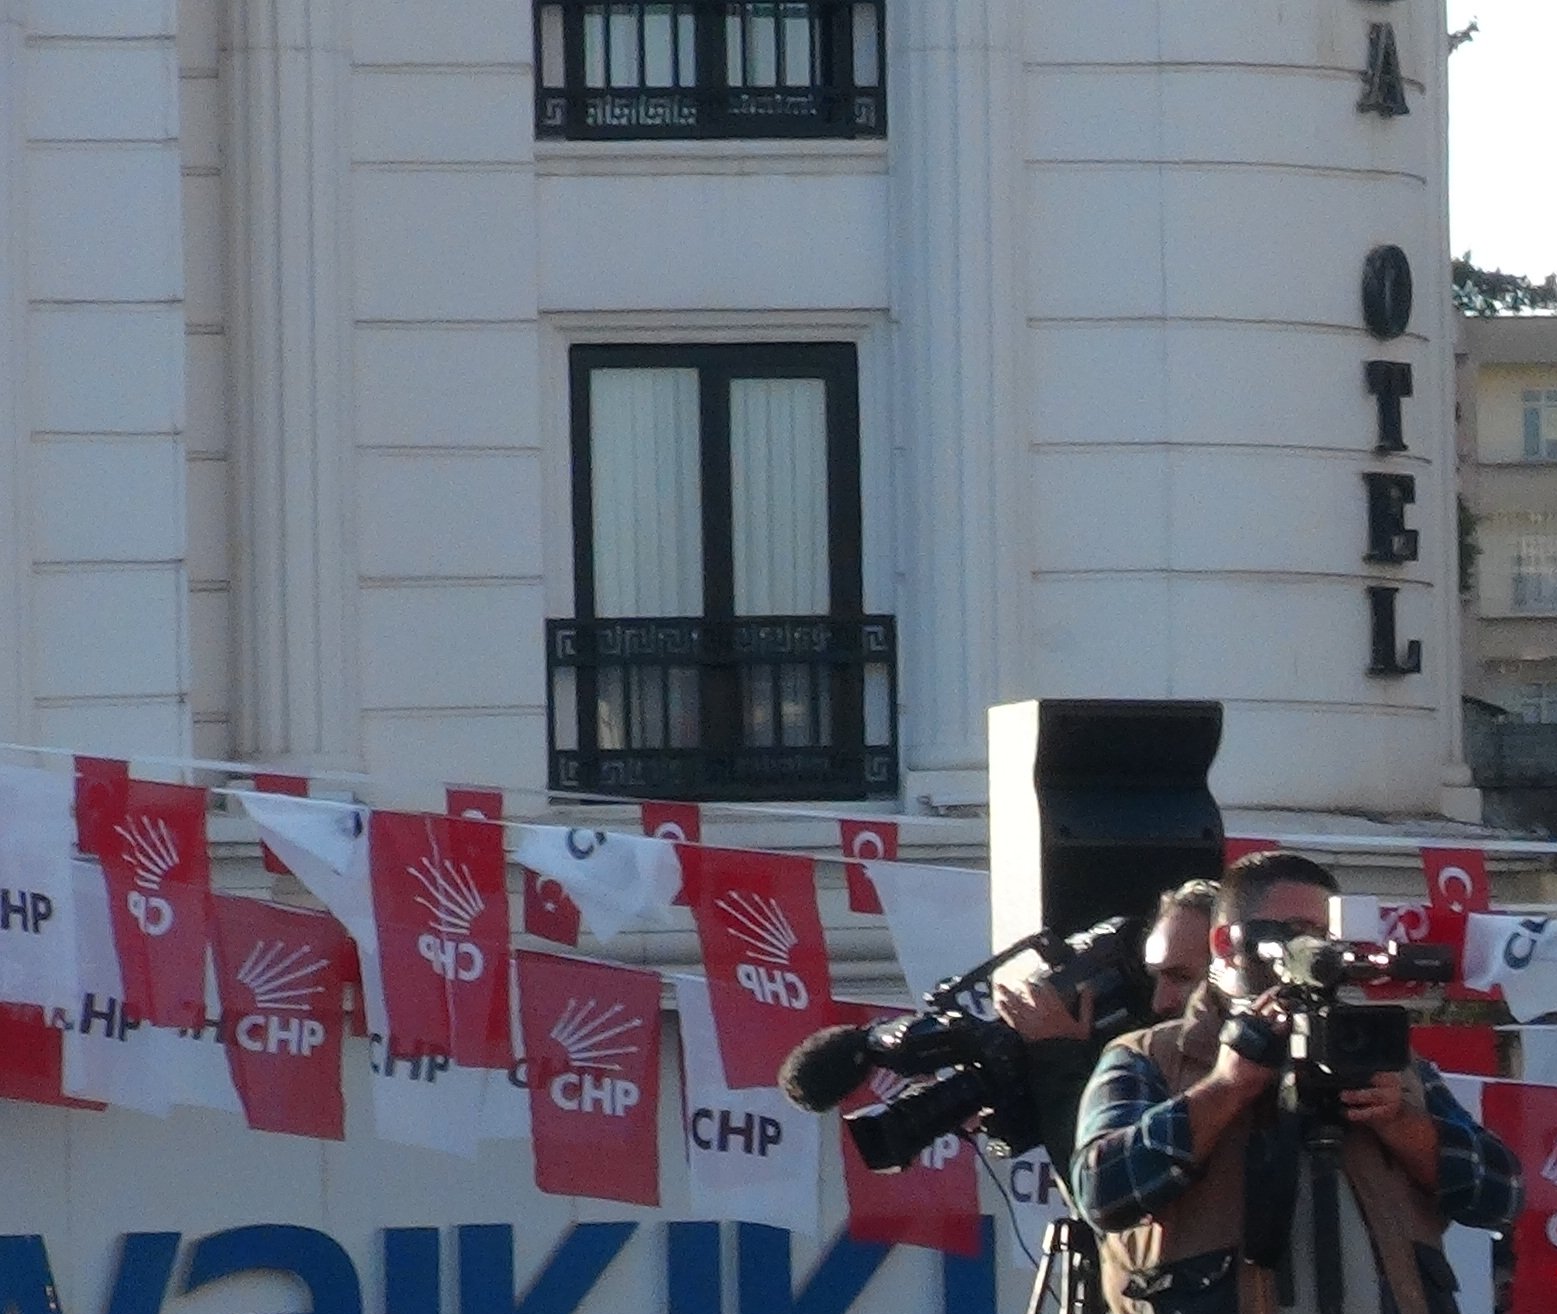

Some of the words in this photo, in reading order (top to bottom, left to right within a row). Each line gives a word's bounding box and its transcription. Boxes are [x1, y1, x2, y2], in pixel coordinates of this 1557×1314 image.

[1361, 243, 1422, 679] OTEL
[0, 887, 53, 934] HP
[234, 1014, 327, 1057] CHP
[550, 1071, 640, 1117] CHP
[691, 1107, 784, 1158] CHP
